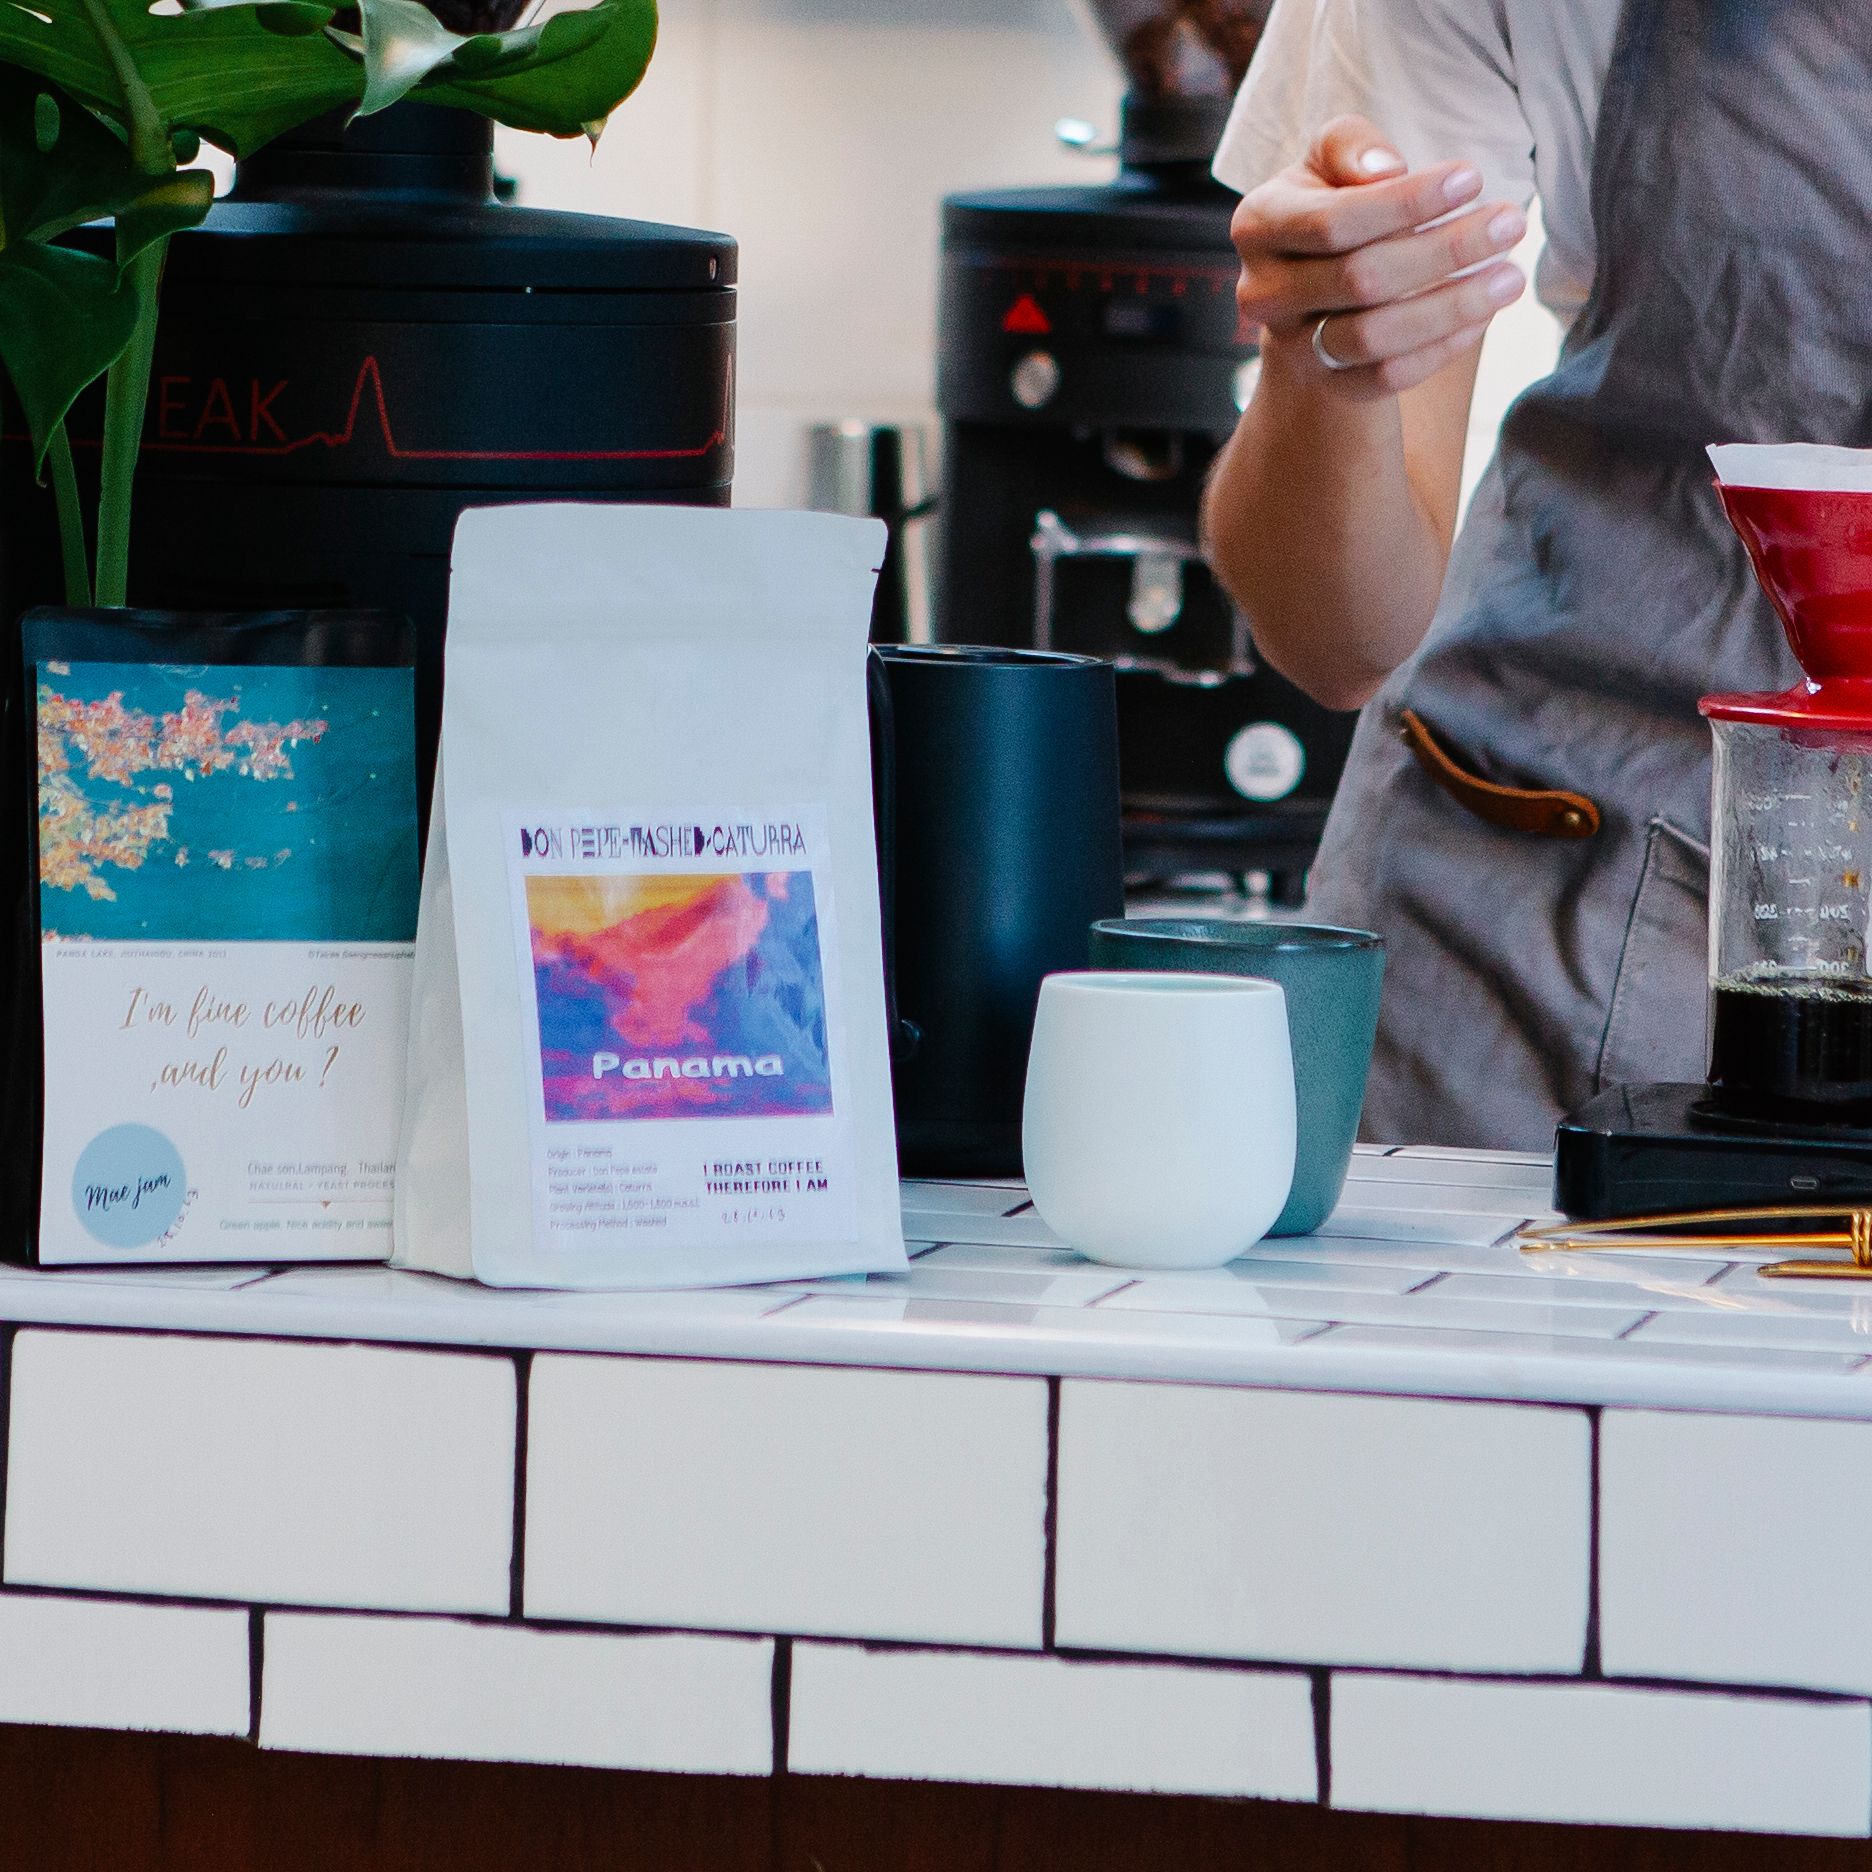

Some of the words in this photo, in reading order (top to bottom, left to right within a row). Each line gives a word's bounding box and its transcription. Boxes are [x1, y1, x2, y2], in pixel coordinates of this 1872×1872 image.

[159, 375, 289, 441] EAK
[520, 826, 563, 859] DON
[119, 986, 177, 1030] I'm
[187, 984, 251, 1039] fine
[264, 984, 367, 1040] coffee
[238, 1057, 306, 1109] you
[319, 1045, 340, 1088] ?
[592, 1051, 785, 1080] Panama
[548, 1166, 586, 1177] Producer
[713, 1162, 762, 1176] ROAST
[768, 1161, 824, 1175] COFFEE
[706, 1179, 791, 1194] THEREFORE
[806, 1178, 829, 1193] AM
[345, 1218, 365, 1228] and
